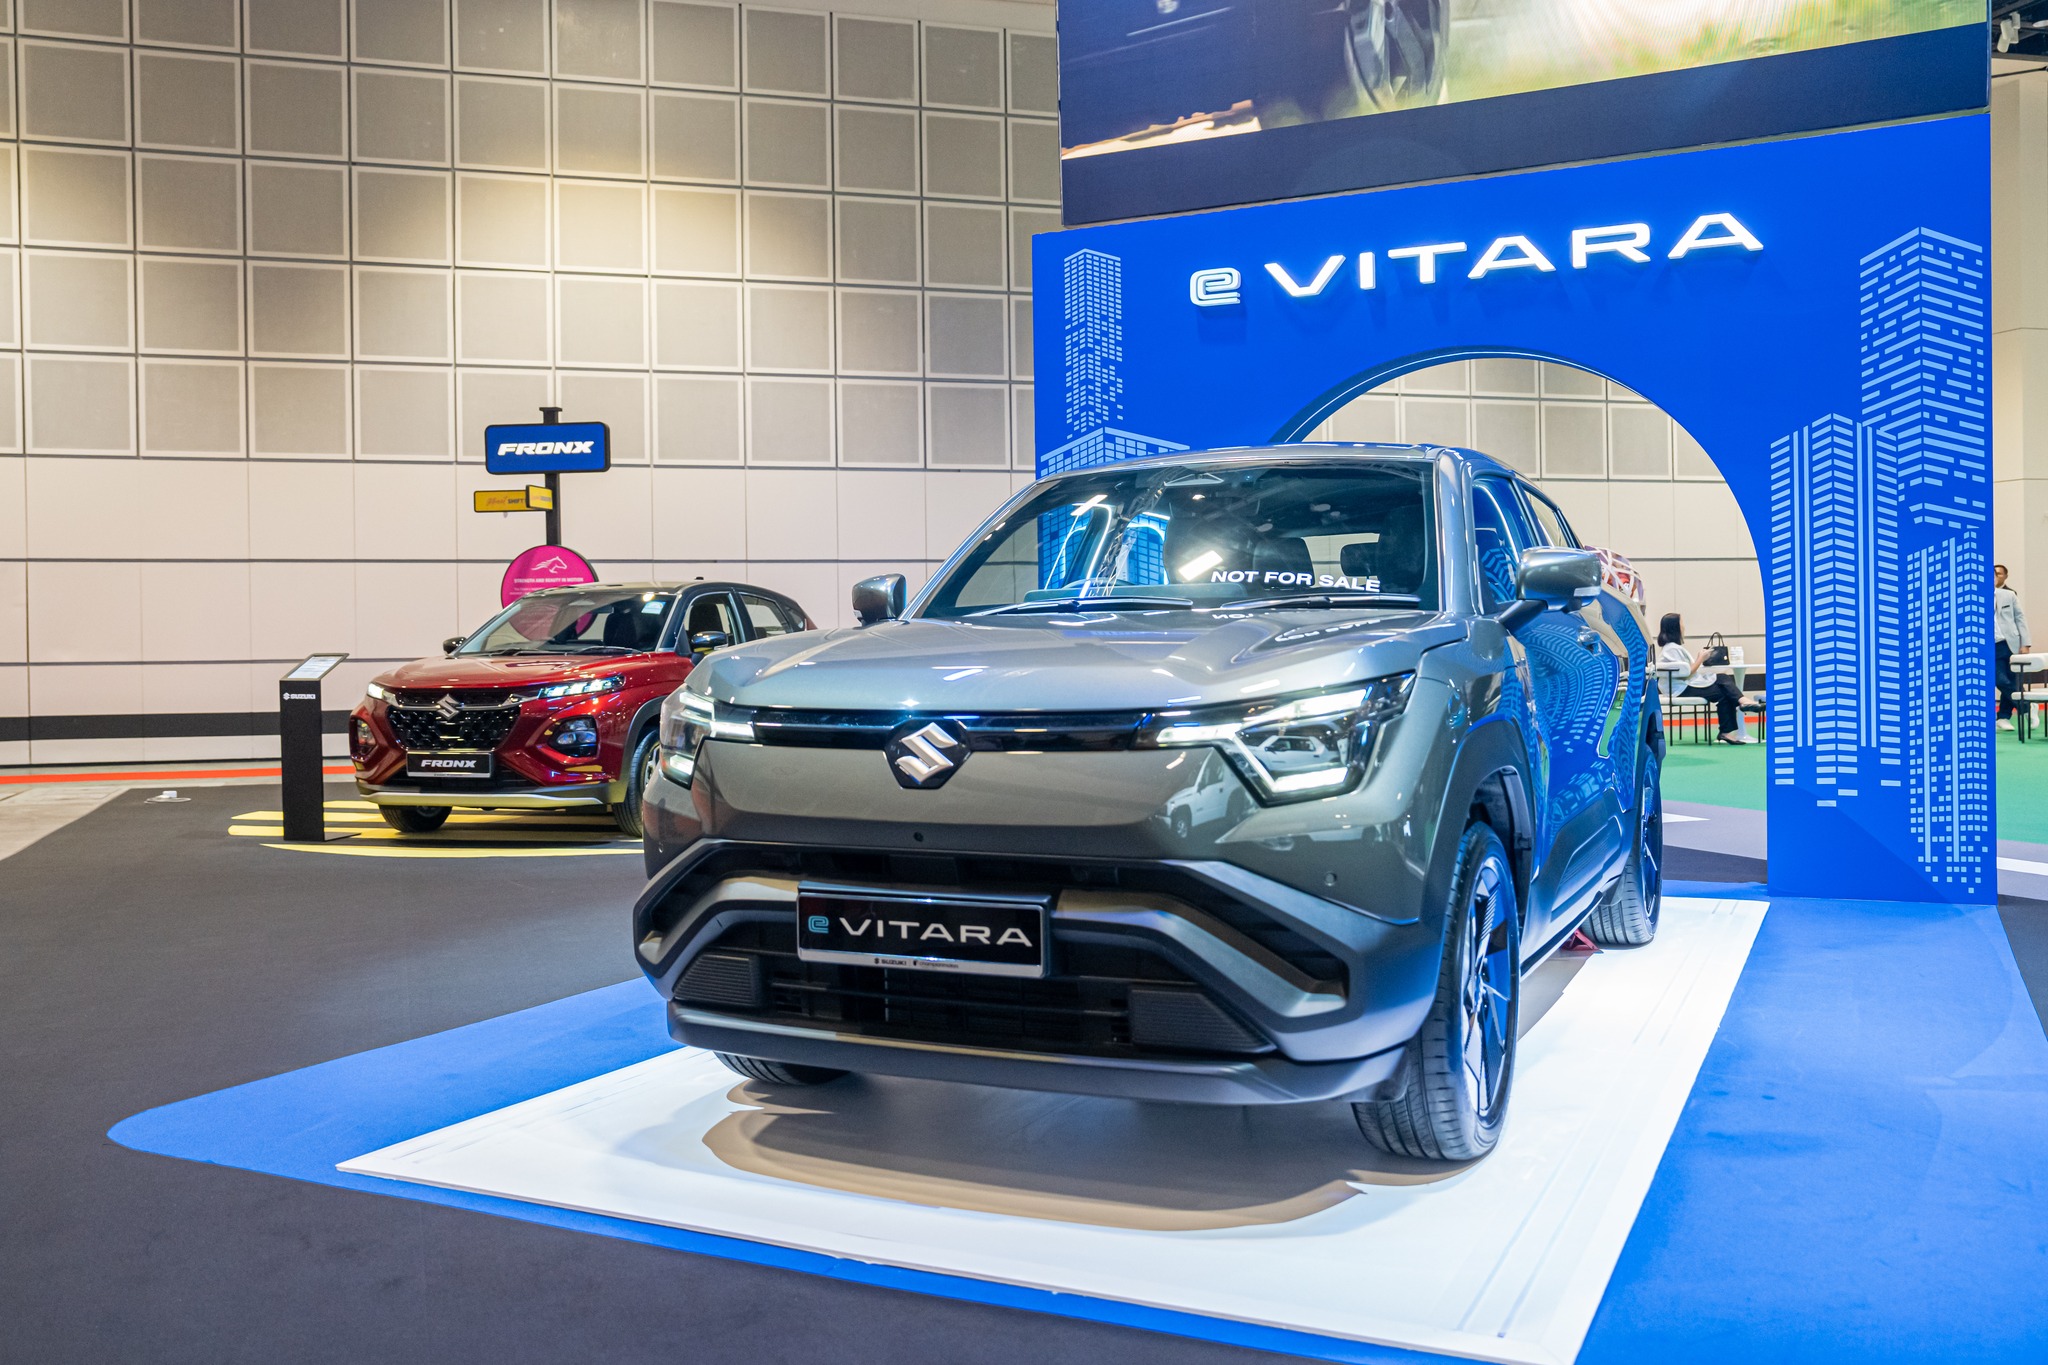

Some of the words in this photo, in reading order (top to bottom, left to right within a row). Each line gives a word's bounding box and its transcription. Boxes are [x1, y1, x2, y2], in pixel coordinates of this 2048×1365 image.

[1264, 212, 1764, 298] VITARA
[497, 440, 595, 456] FRONX
[1210, 571, 1259, 583] NOT
[1264, 571, 1313, 586] FOR
[1318, 575, 1381, 592] SALE
[421, 759, 477, 768] FRONX
[839, 917, 1033, 947] VITARA
[881, 958, 907, 966] SUZUKI
